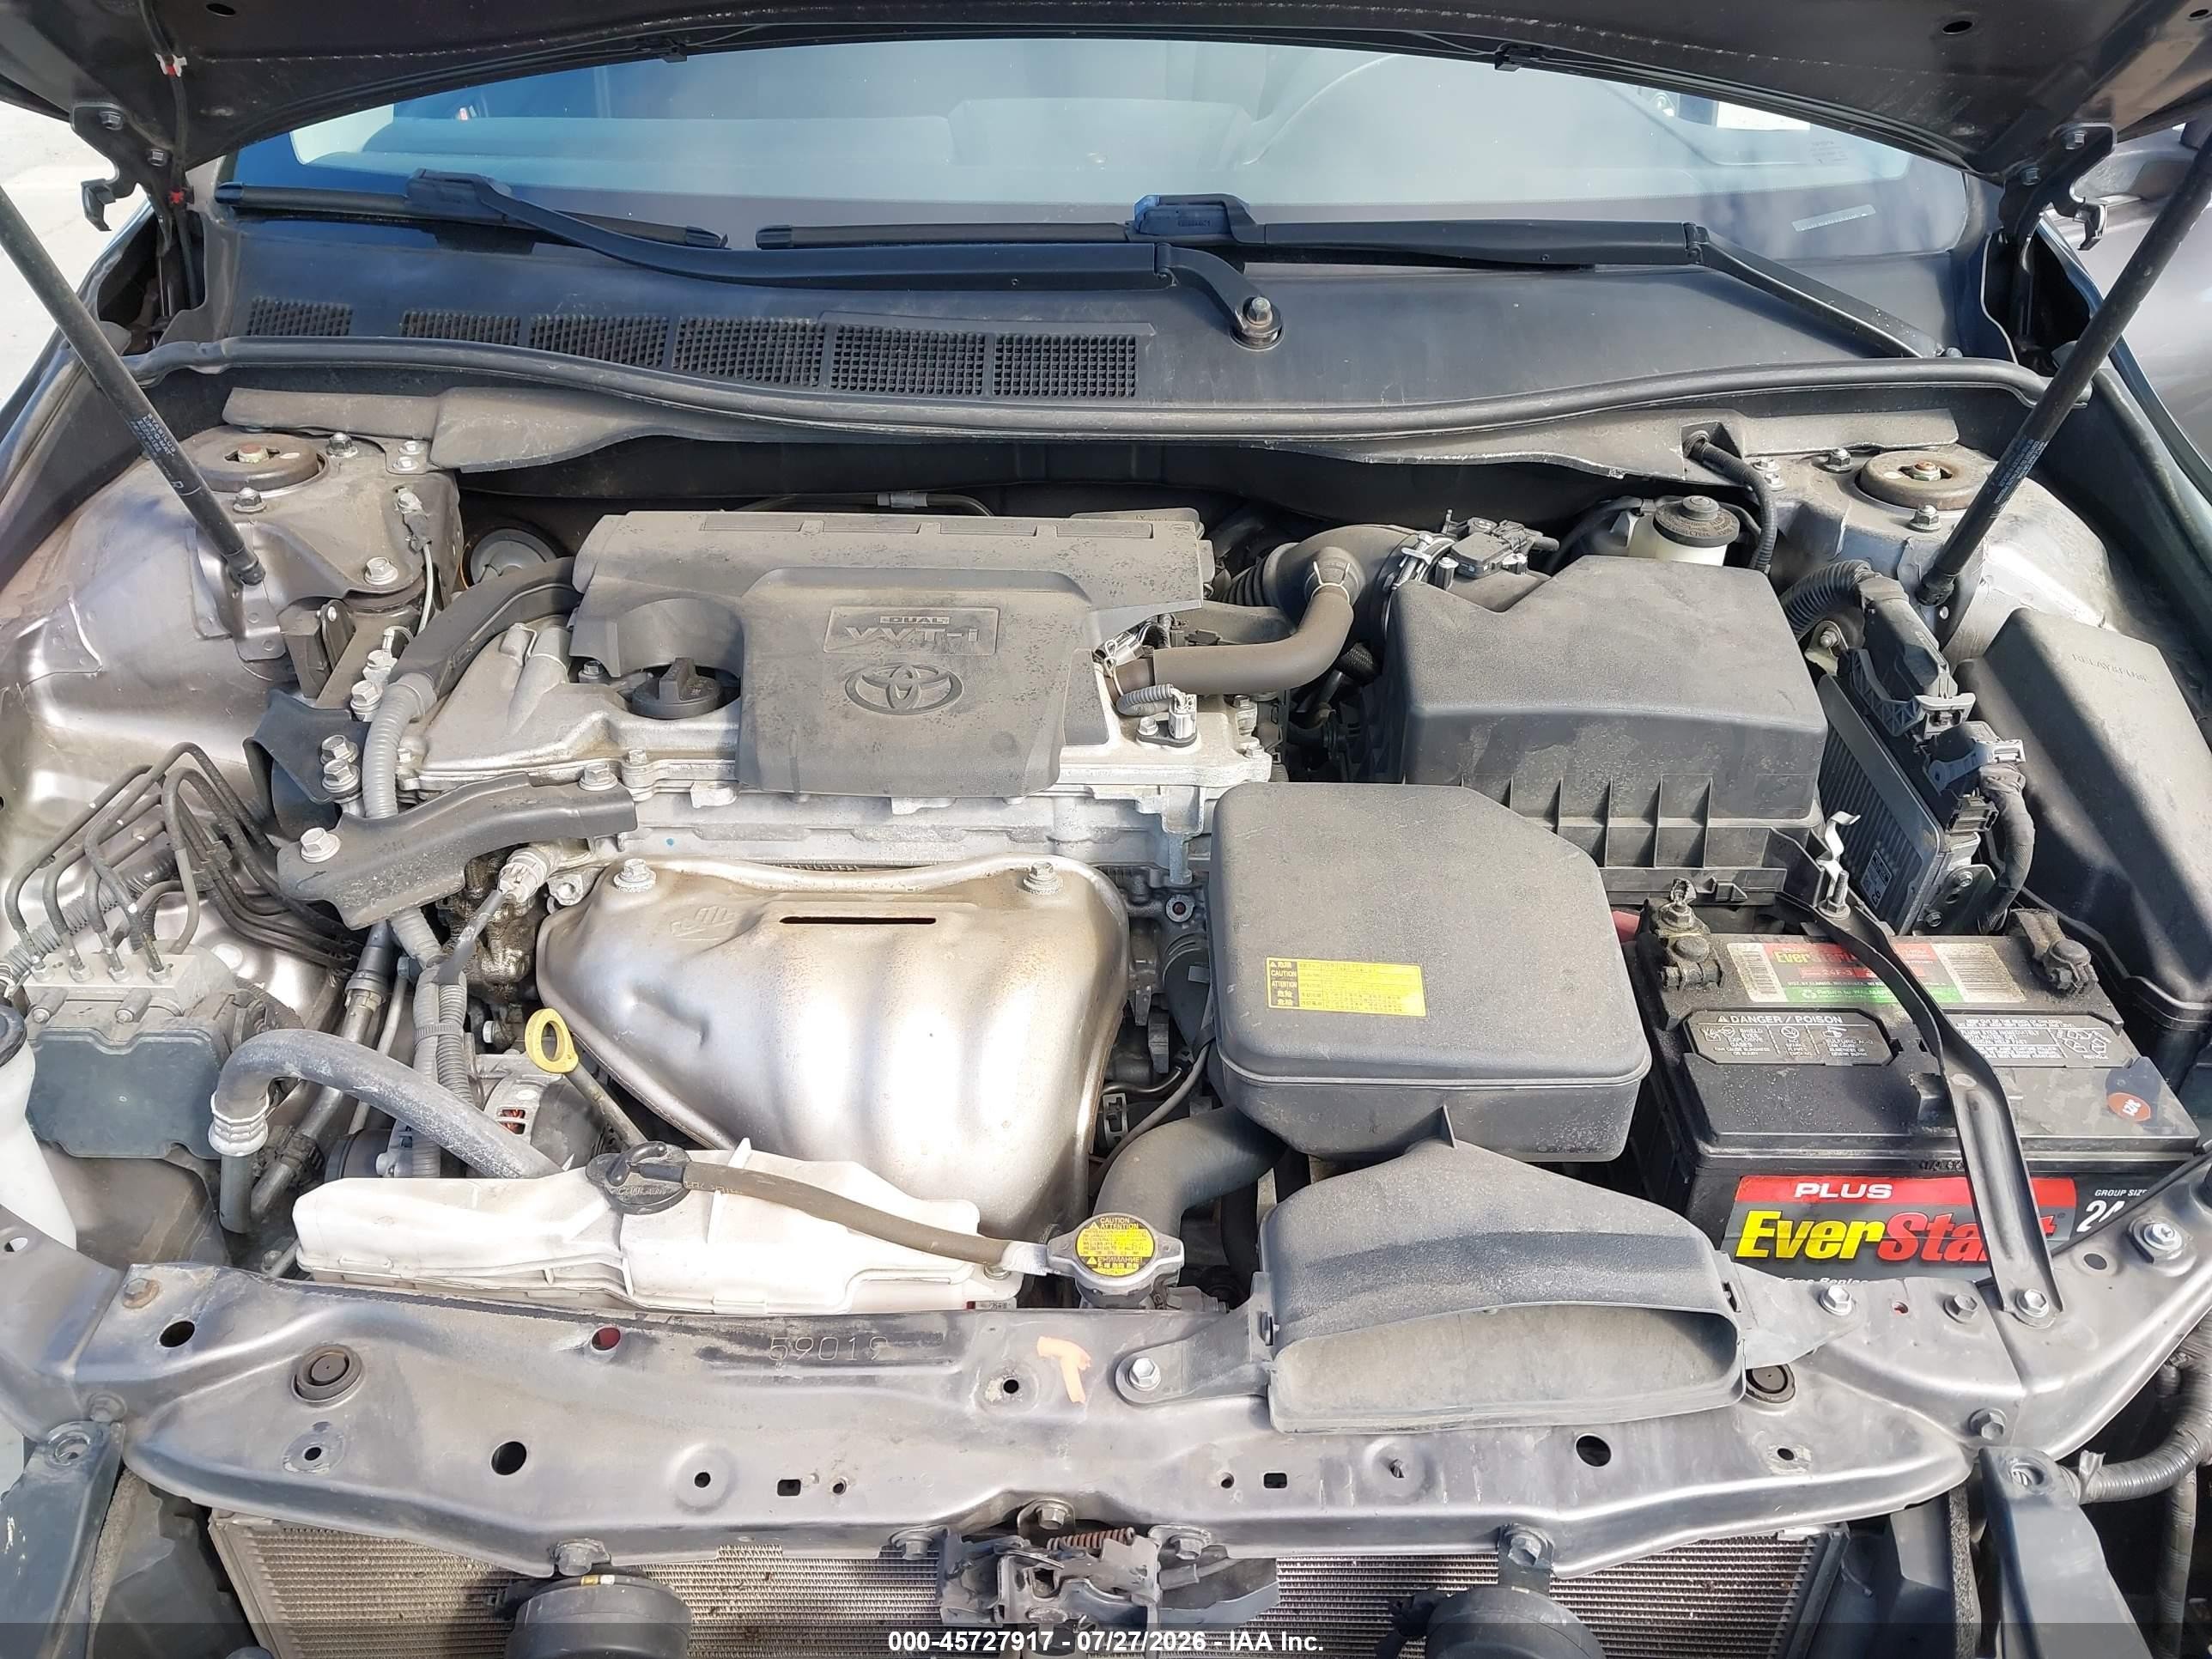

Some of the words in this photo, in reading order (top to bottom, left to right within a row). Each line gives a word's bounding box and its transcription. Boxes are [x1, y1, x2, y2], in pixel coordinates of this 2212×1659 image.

[1729, 1015, 1782, 1024] DANGER
[1796, 1016, 1844, 1024] POISON
[1795, 1182, 1893, 1199] PLUS
